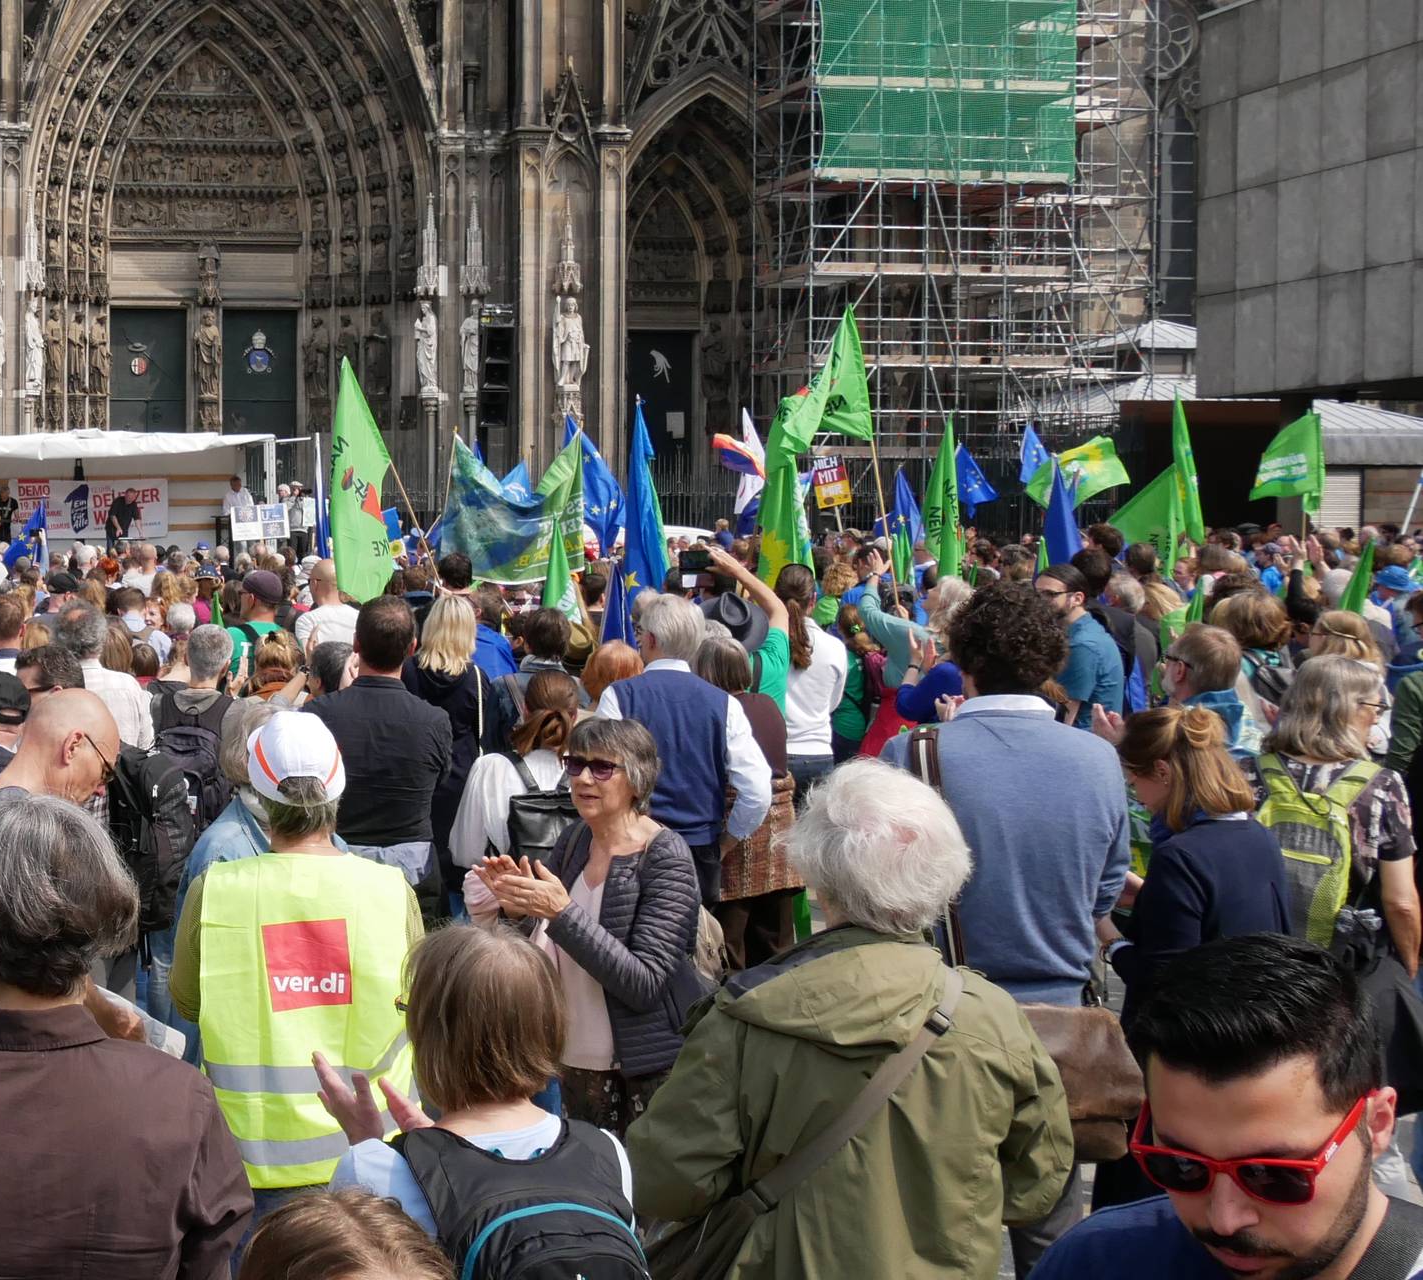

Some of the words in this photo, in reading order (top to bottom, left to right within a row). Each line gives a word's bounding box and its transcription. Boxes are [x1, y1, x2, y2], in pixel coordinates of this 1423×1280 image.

[818, 468, 838, 485] MIT
[17, 484, 51, 497] DEMO
[273, 971, 345, 995] ver.di
